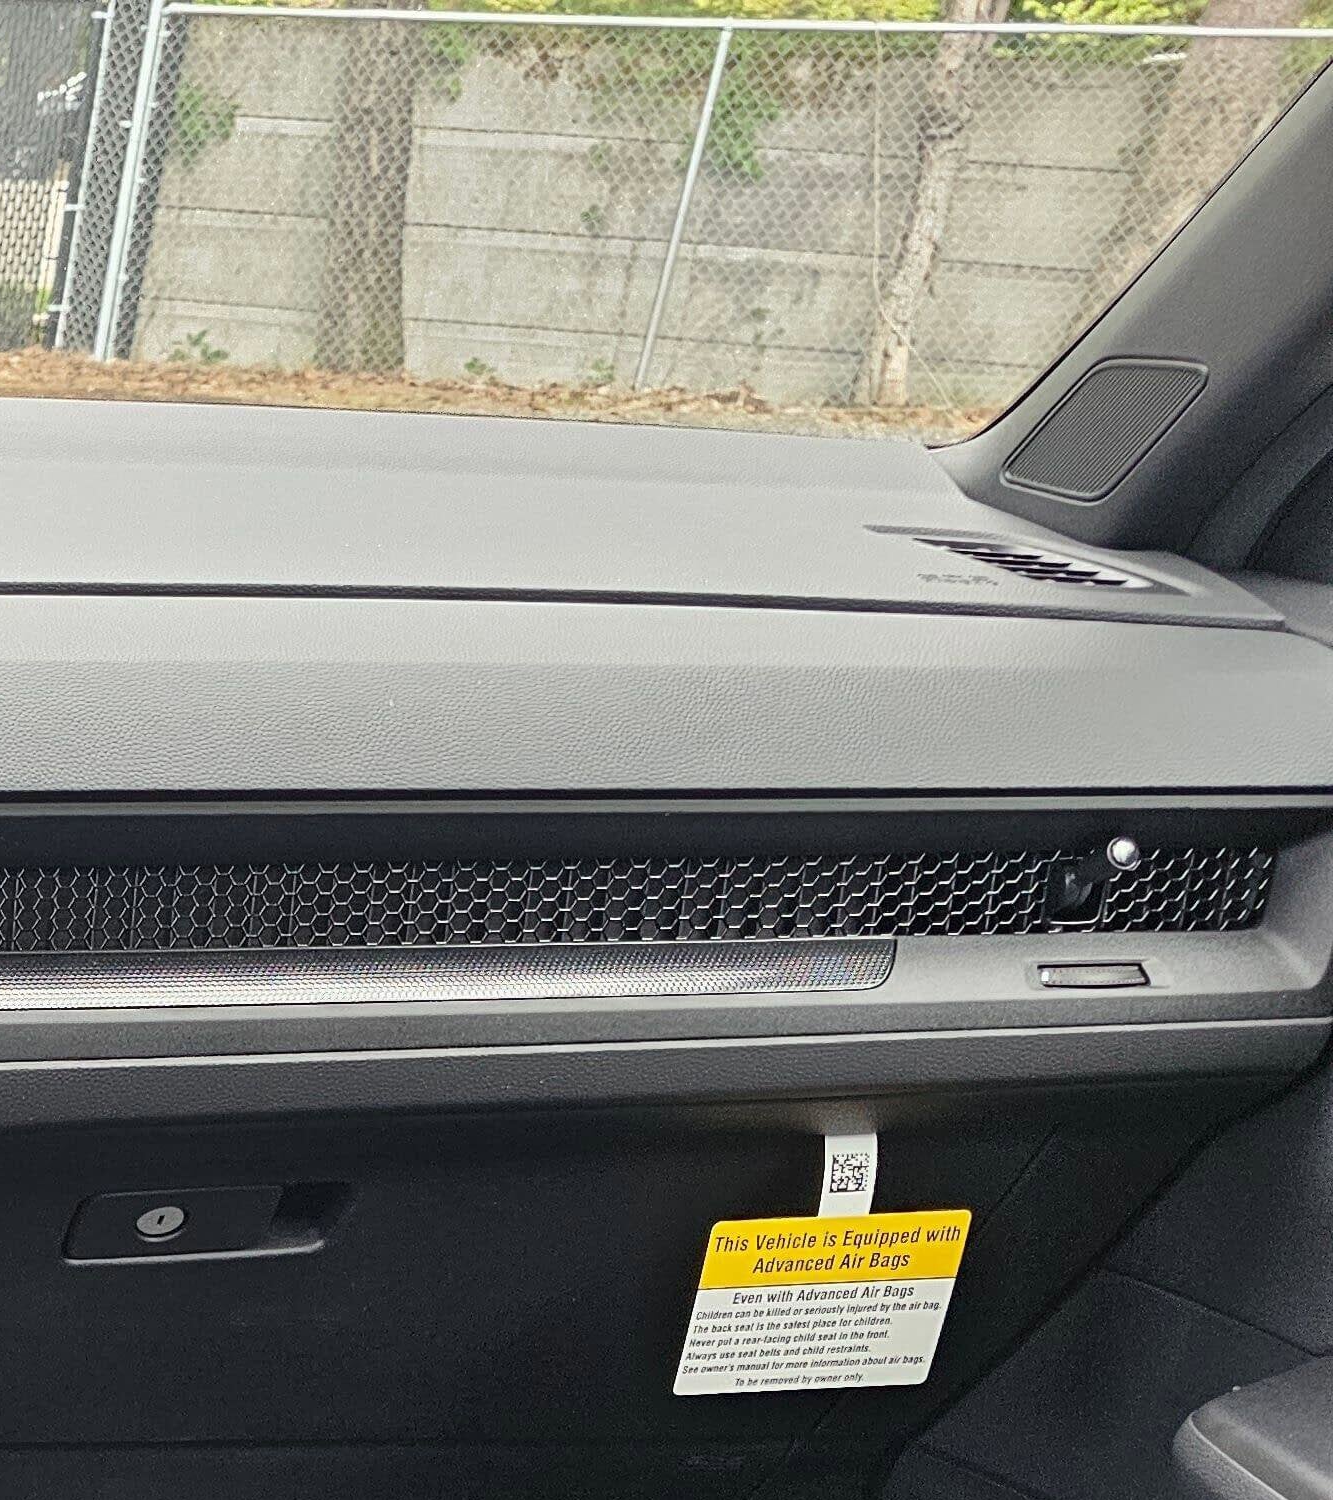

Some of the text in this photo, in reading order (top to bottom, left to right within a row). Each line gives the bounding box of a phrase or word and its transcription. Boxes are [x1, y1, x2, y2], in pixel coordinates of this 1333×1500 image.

[715, 1225, 960, 1252] This Vehicle is Equipped with
[753, 1252, 911, 1274] Advanced Air Bags
[732, 1285, 914, 1305] Even with Advanced Air Bags
[696, 1300, 942, 1321] Children can be killed or seriously injured by the air bag.
[693, 1317, 893, 1334] The back seat is the safest place for children.
[689, 1330, 890, 1348] Never put a rear-facing child seat in the front.
[685, 1344, 871, 1362] Always use seat belts and child restraints.
[682, 1355, 925, 1374] See owner's manual for more information about air bags.
[735, 1372, 864, 1387] To be removed by owner only.
